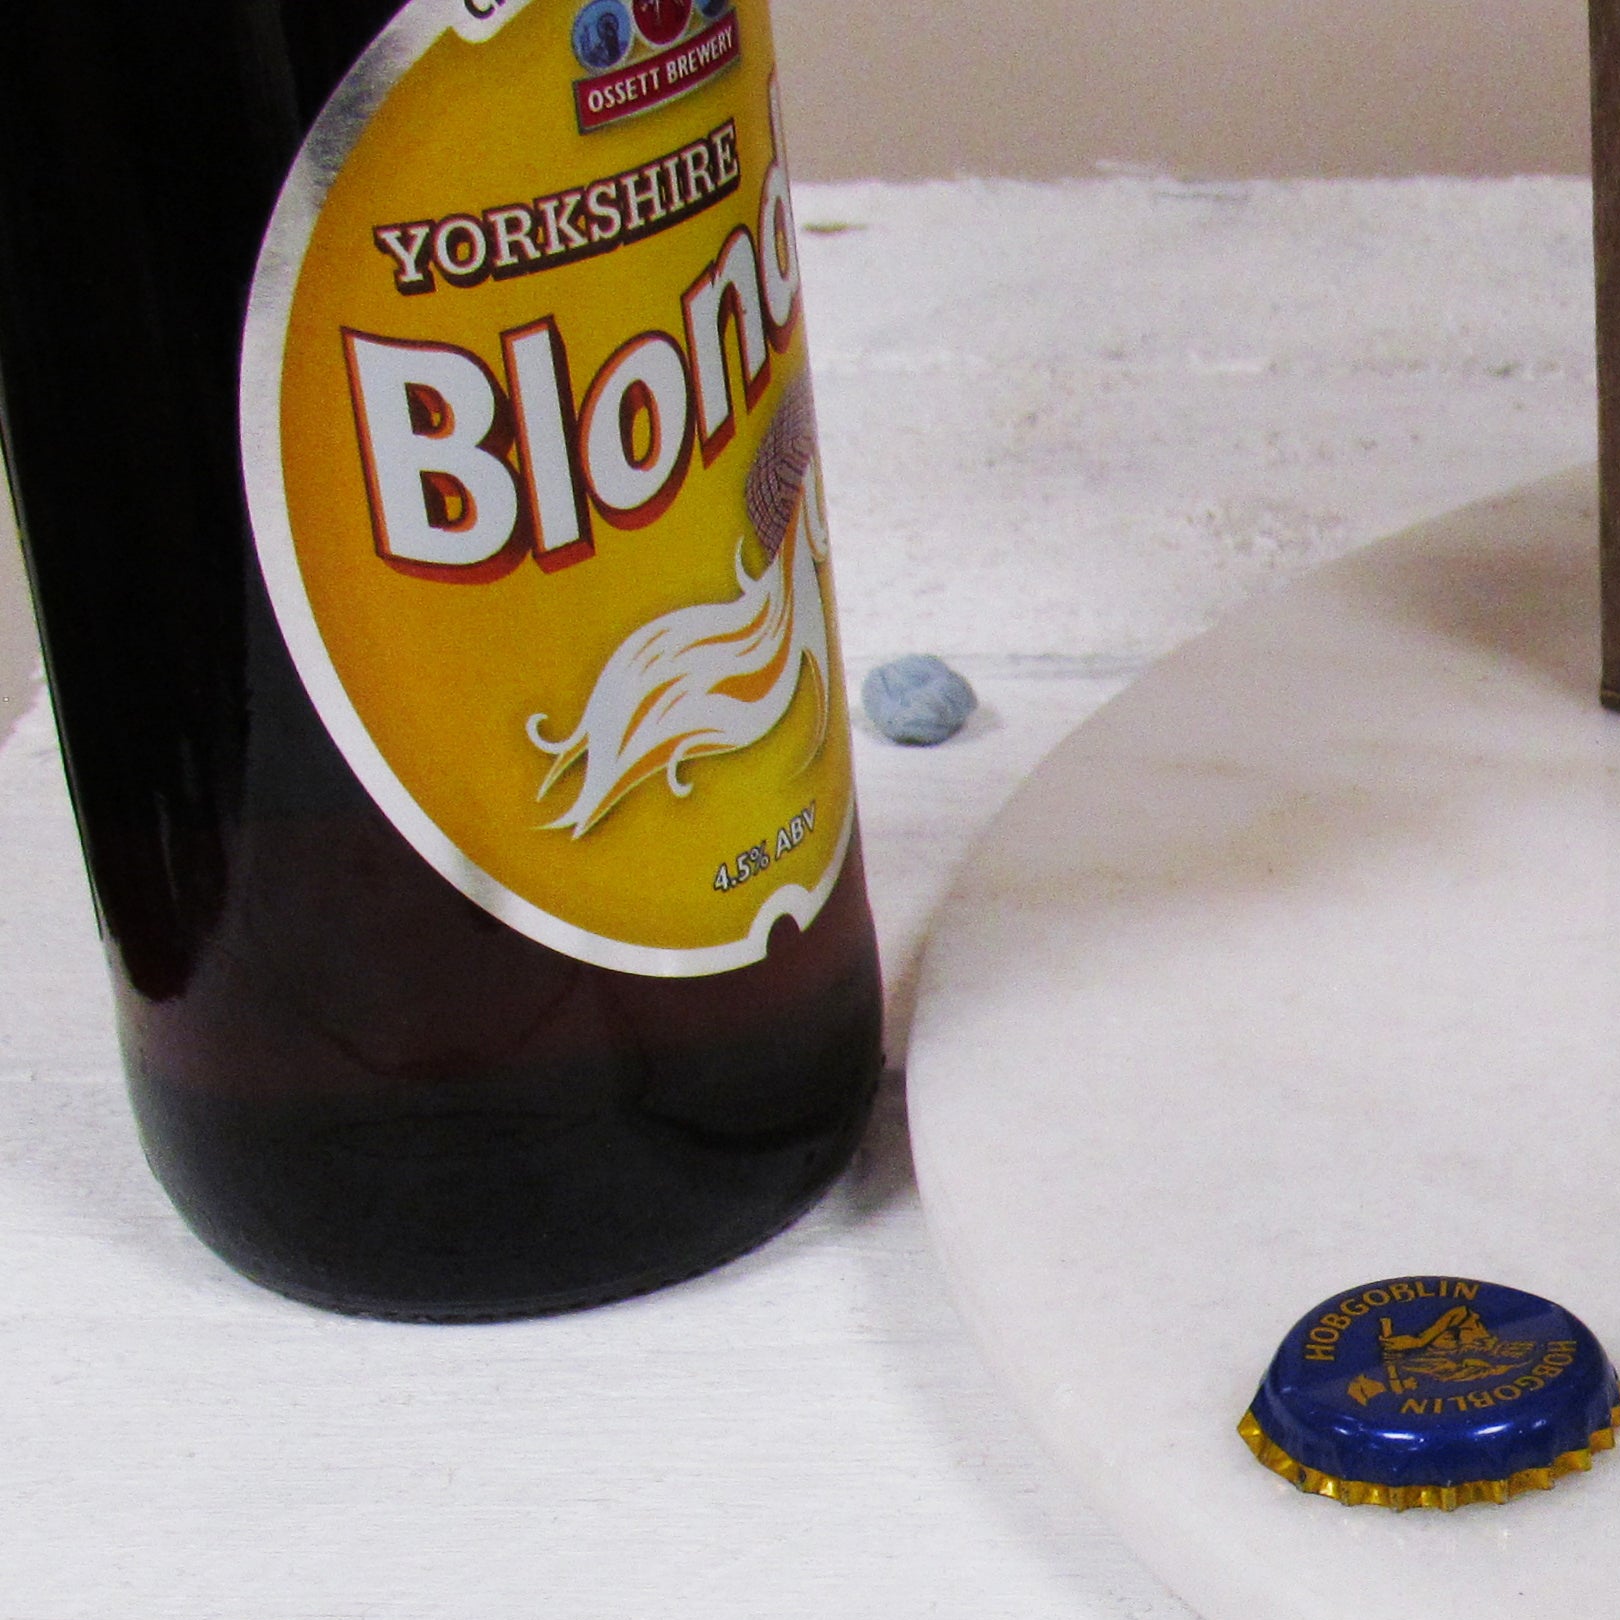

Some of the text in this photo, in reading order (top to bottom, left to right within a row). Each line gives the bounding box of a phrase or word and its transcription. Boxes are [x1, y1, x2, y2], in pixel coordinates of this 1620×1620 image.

[587, 26, 733, 113] OSSETT BREWERY
[374, 117, 740, 296] YORKSHIRE
[713, 798, 817, 893] 4.5% ABV
[1304, 1280, 1480, 1362] HOBGOBLIN
[1400, 1339, 1578, 1415] HOBGOBLIN
